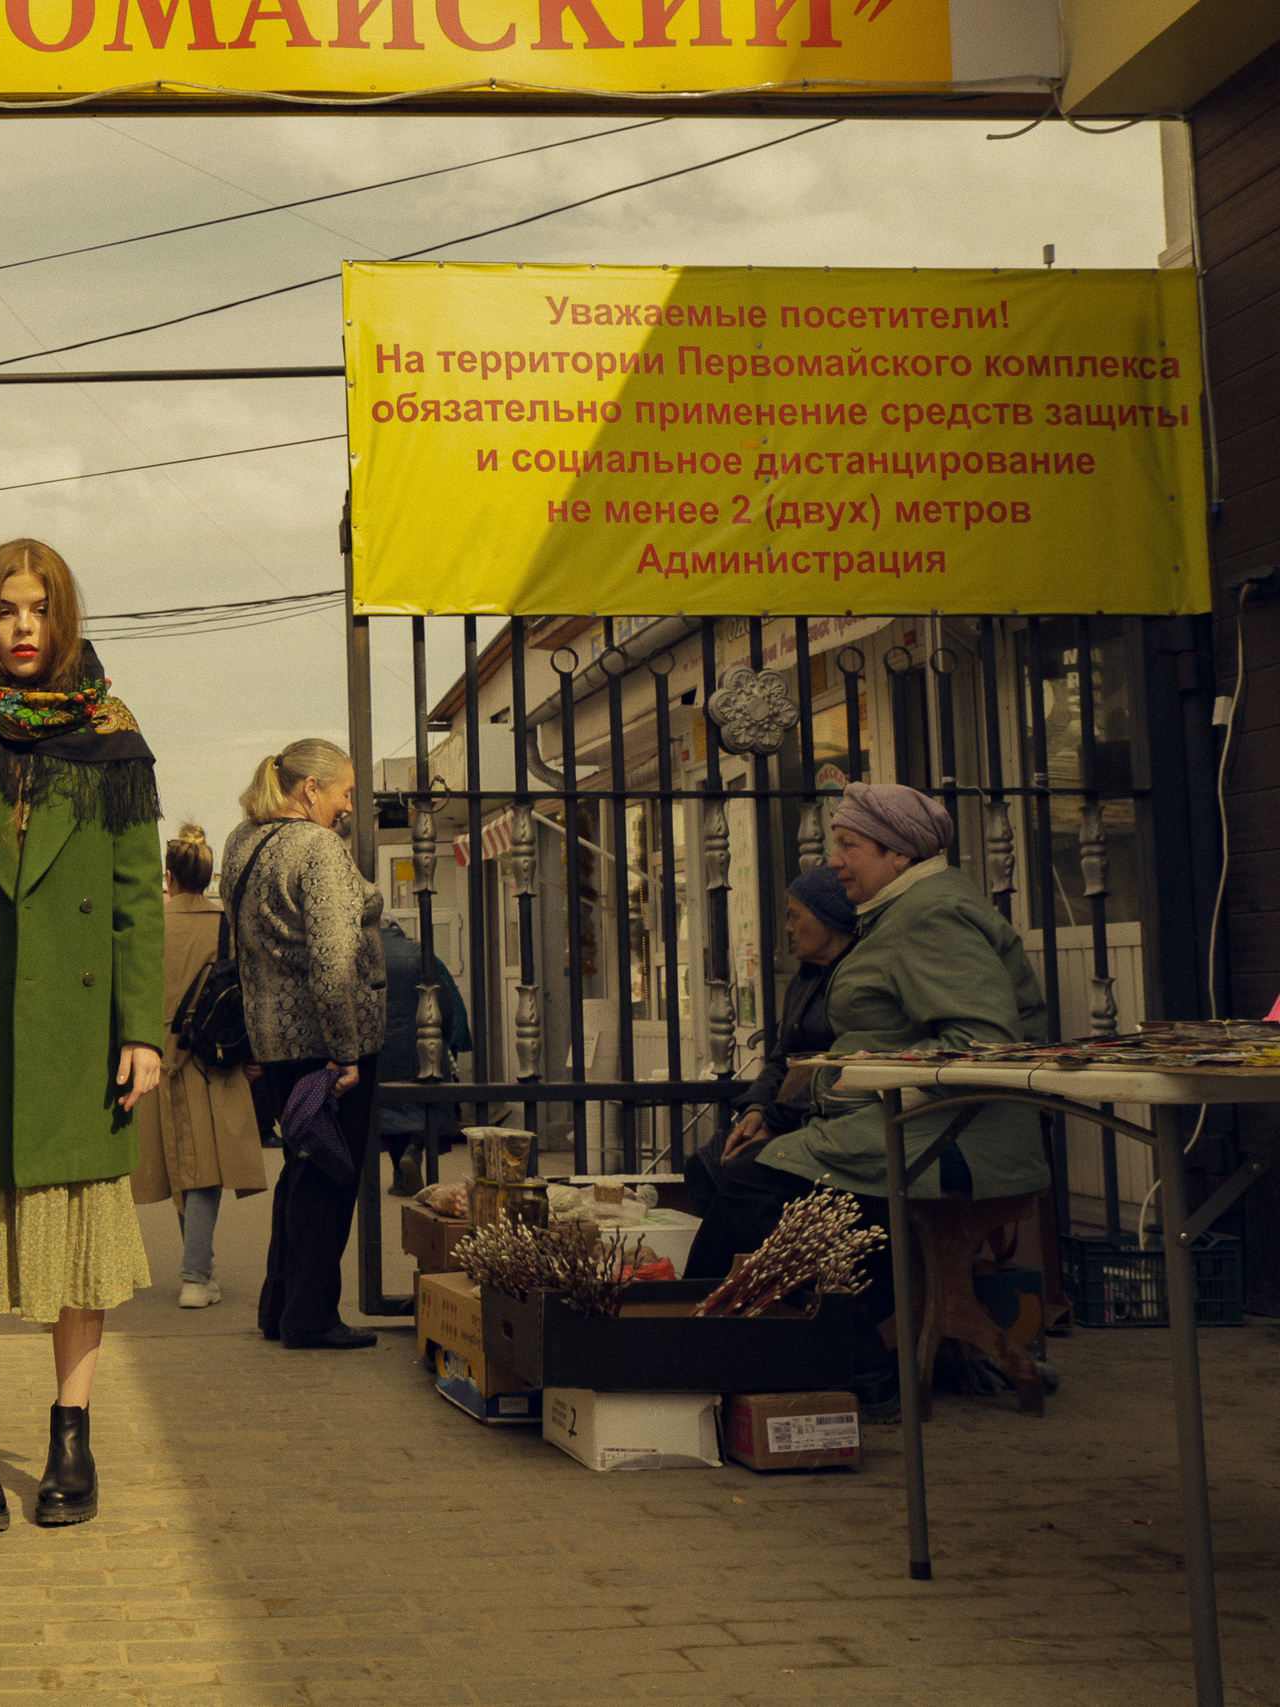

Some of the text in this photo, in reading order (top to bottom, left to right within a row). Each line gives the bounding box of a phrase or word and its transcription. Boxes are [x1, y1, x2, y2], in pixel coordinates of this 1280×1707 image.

[545, 295, 1009, 330] Уважаемые посетители!
[376, 343, 1181, 384] На территории Первомайского комплекса
[371, 395, 1190, 433] обязательно применение средств защиты
[476, 449, 1097, 482] и социальное дистанцирование
[547, 492, 1033, 533] не менее 2 (двух) метров
[636, 542, 947, 582] Администрация
